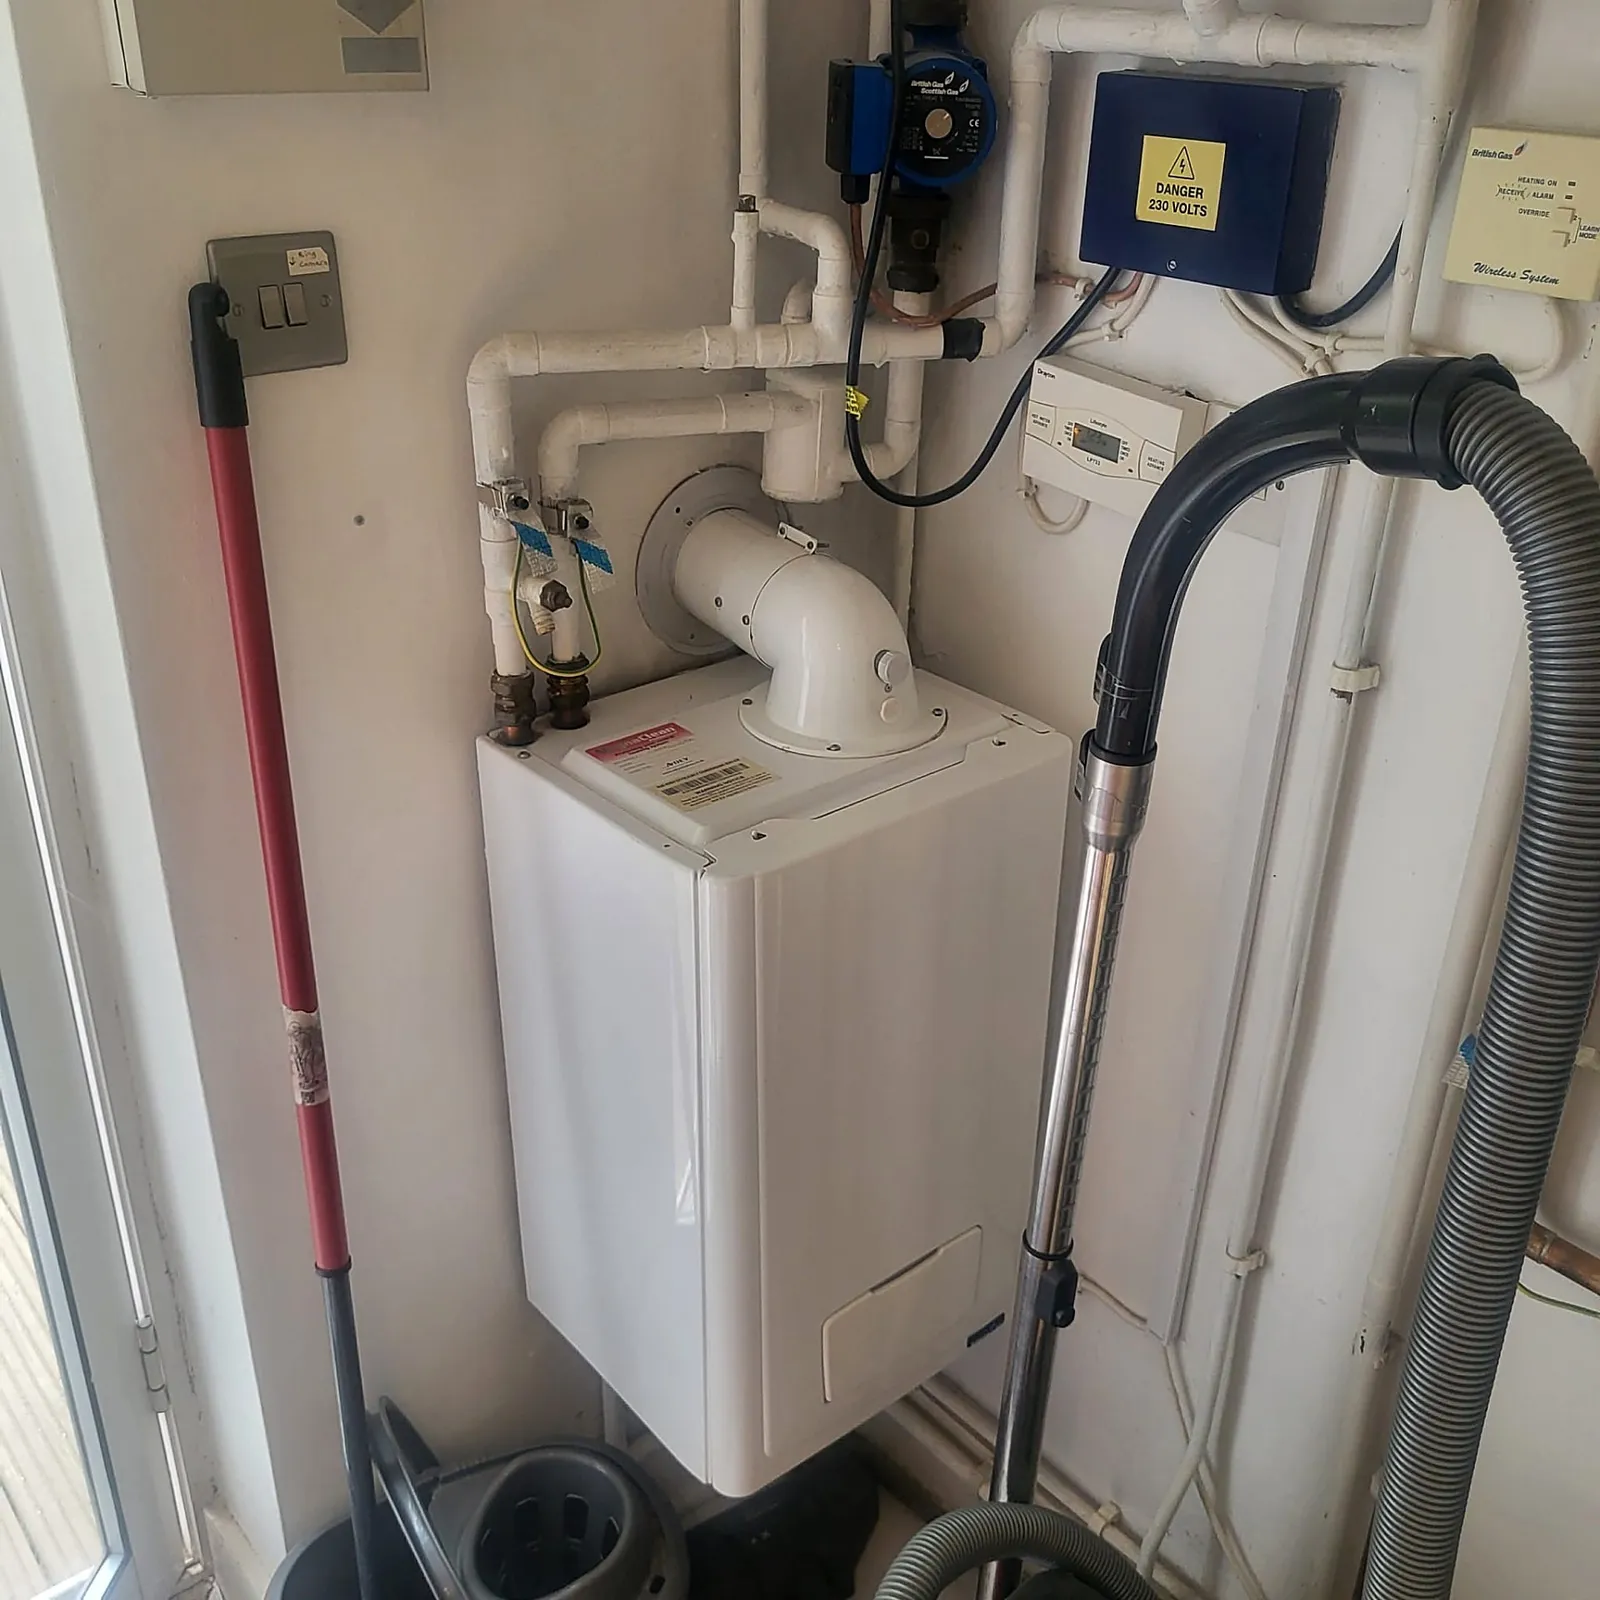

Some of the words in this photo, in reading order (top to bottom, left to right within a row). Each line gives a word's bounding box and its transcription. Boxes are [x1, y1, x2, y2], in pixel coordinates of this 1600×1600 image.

[1472, 149, 1497, 159] British
[1498, 151, 1513, 160] Gas
[1518, 177, 1545, 185] HEATING
[1156, 182, 1204, 199] DANGER
[1532, 191, 1555, 200] ALARM
[1149, 199, 1169, 212] 230
[1172, 201, 1208, 217] VOLTS
[1518, 208, 1550, 218] OVERRIDE
[1474, 262, 1517, 278] Wireless
[1520, 270, 1560, 284] System
[1037, 368, 1056, 379] Drayton
